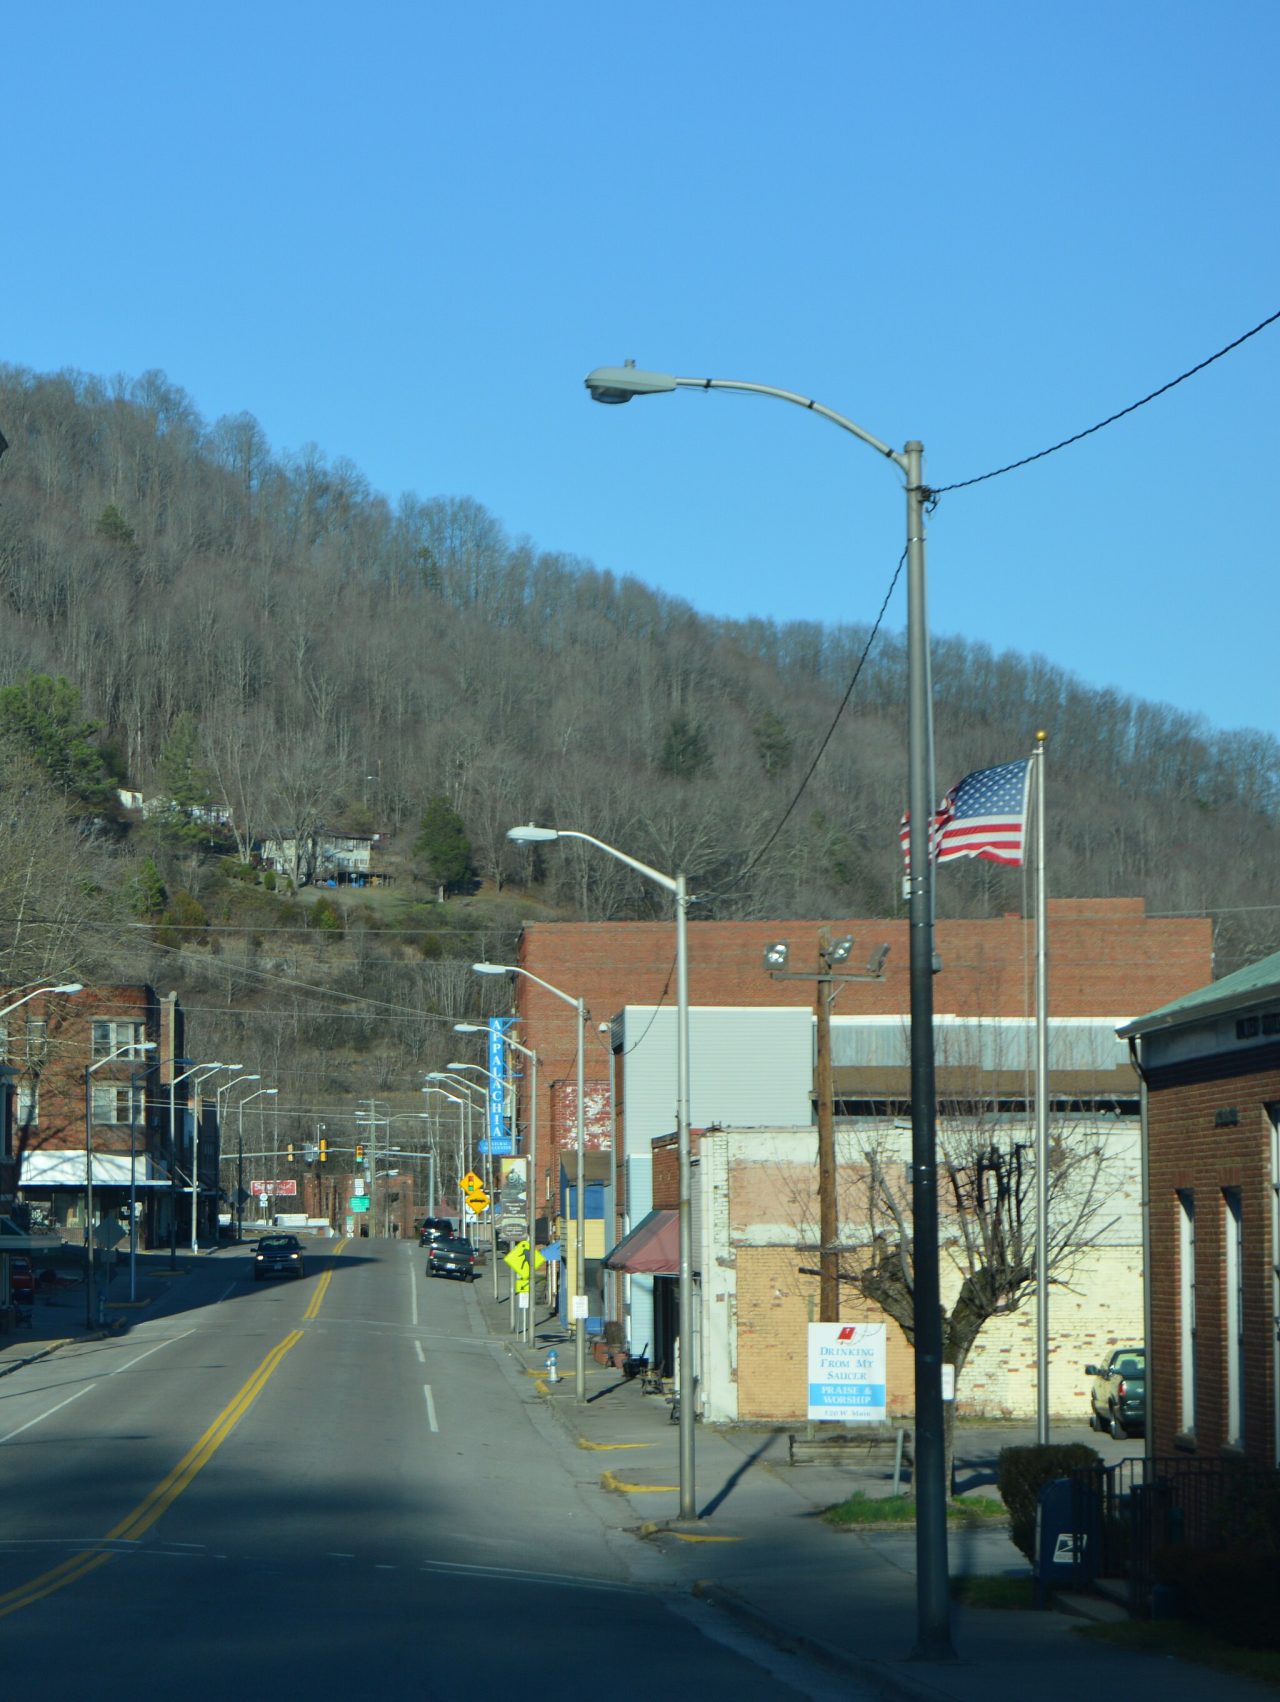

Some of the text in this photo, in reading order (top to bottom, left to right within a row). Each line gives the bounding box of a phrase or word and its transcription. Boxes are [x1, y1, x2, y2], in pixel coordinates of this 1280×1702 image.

[492, 1019, 502, 1137] APPALACHIA
[820, 1346, 874, 1356] DRINKING
[820, 1359, 874, 1368] FROM MY
[827, 1371, 867, 1380] SAUCER
[821, 1386, 872, 1395] PRAISE &
[823, 1396, 872, 1404] WORSHIP
[851, 1409, 871, 1417] Main
